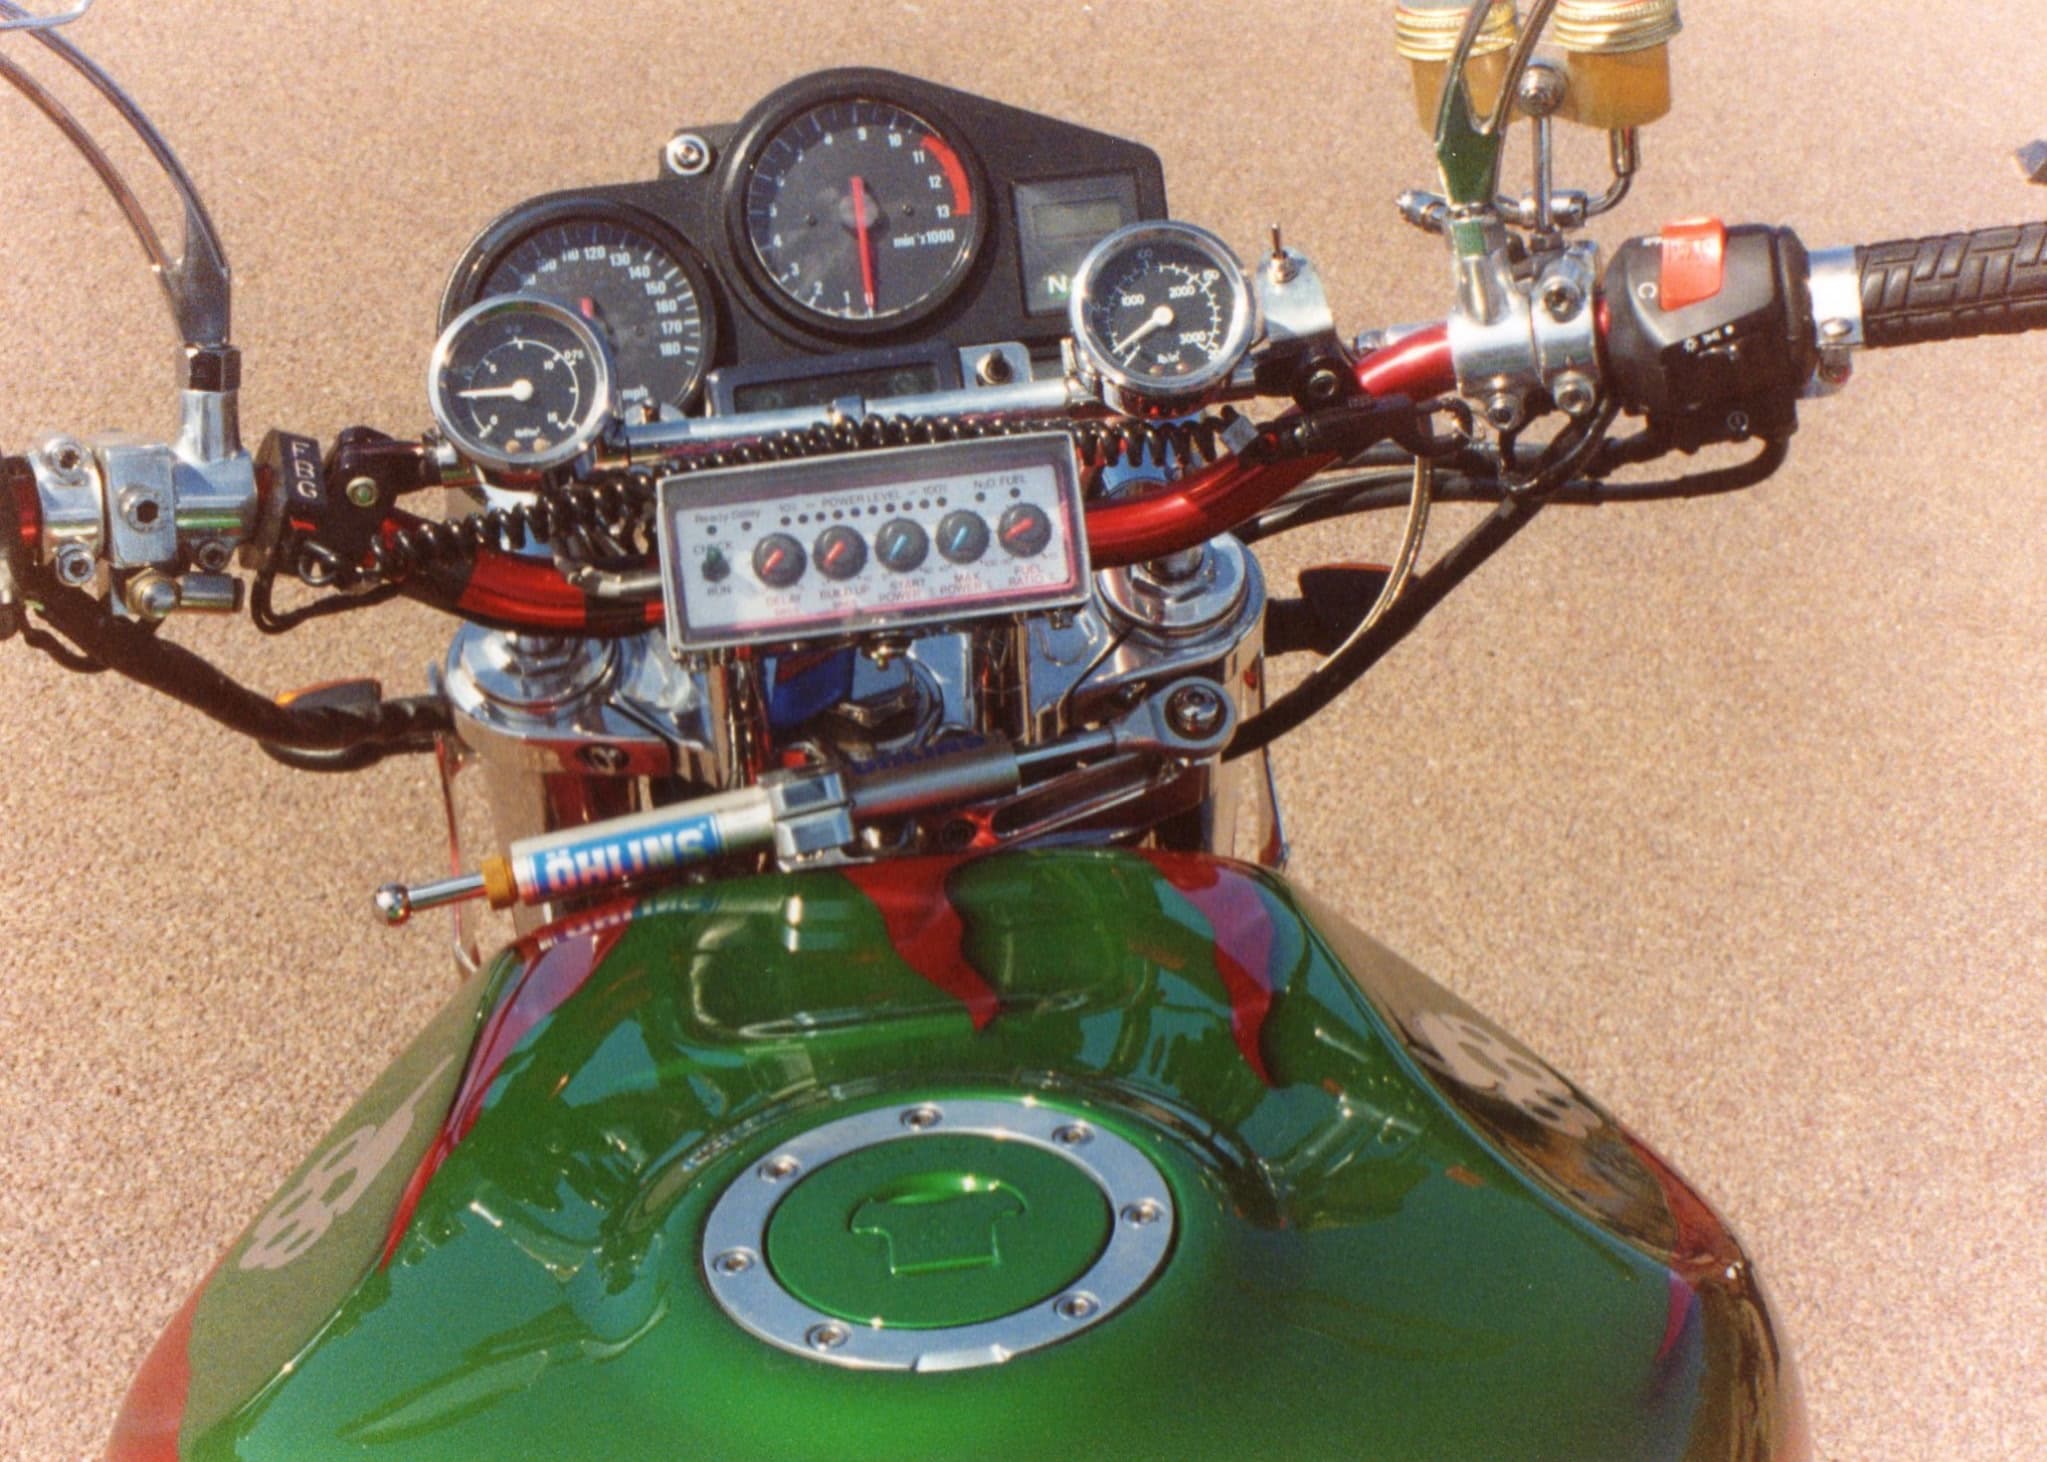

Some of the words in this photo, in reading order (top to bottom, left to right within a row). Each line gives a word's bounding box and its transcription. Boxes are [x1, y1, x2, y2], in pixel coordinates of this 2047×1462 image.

[912, 150, 925, 165] 11
[928, 173, 942, 189] 12
[936, 203, 951, 219] 13
[583, 245, 606, 261] 120
[609, 250, 631, 267] 130
[628, 265, 651, 280] 140
[644, 280, 667, 296] 150
[1047, 275, 1067, 295] N
[655, 299, 678, 314] 160
[660, 319, 683, 335] 170
[622, 384, 649, 400] mph
[999, 473, 1026, 485] FUEL
[822, 492, 863, 507] POWER
